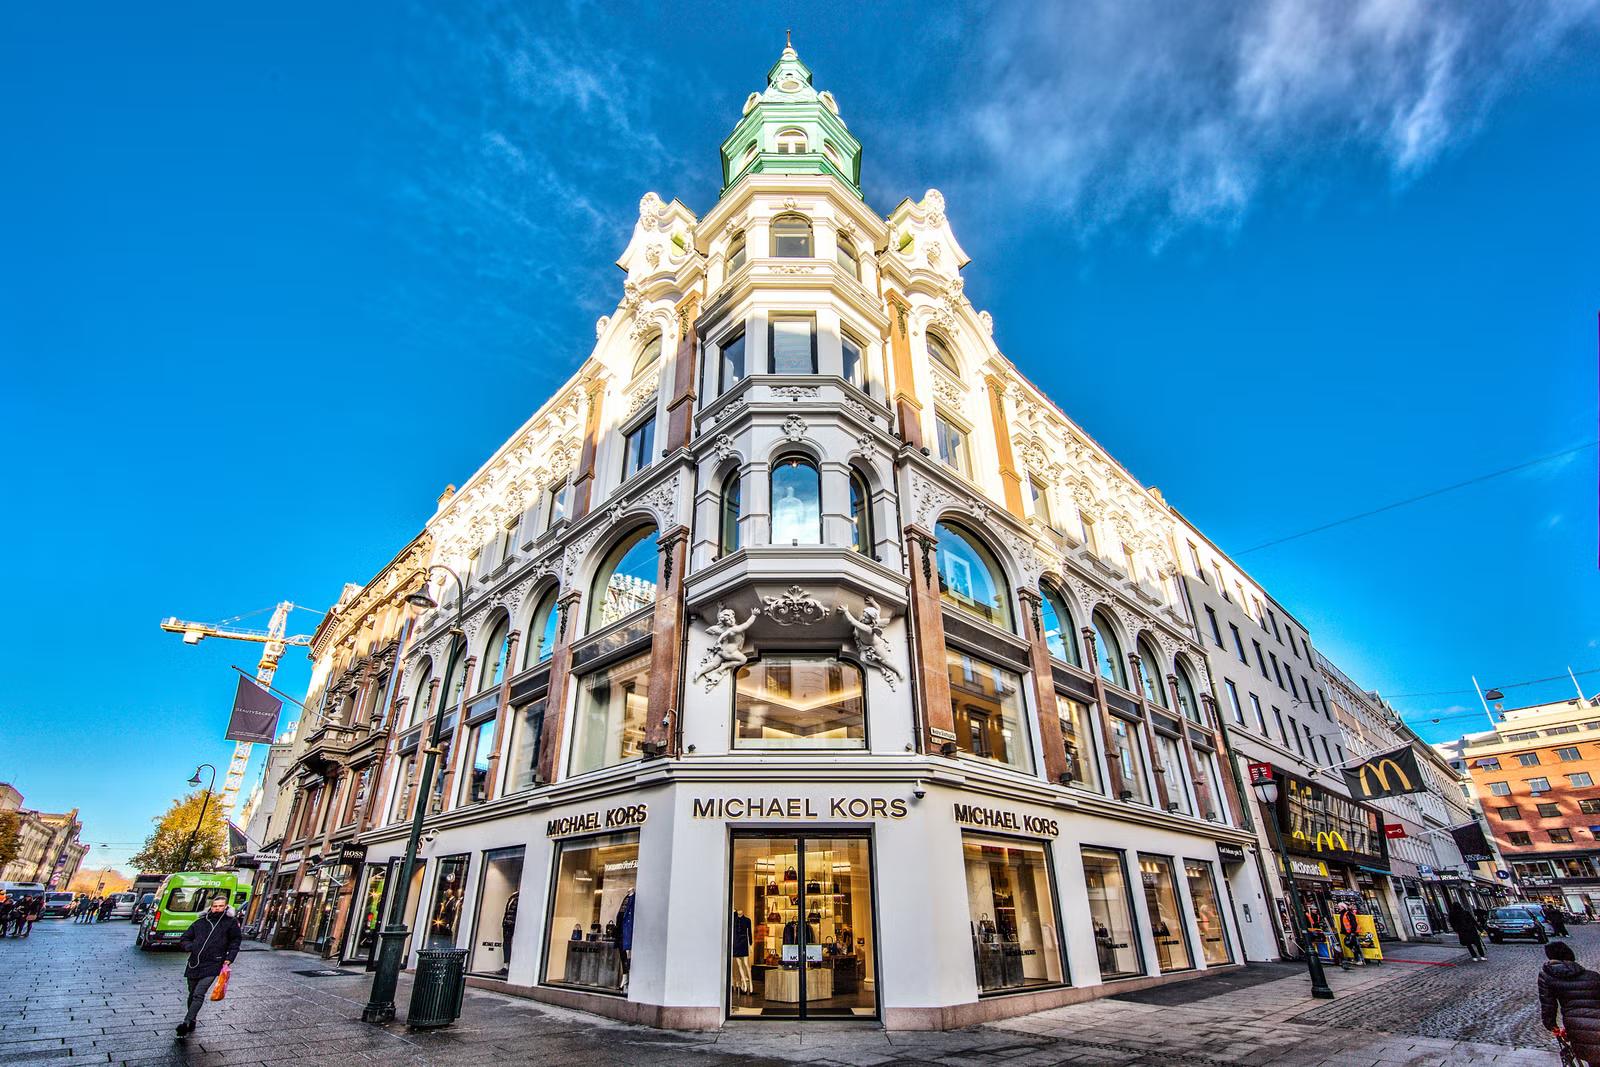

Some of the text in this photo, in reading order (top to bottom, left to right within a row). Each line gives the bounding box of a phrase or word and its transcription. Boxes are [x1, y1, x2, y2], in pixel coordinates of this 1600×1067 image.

[546, 804, 647, 837] MICHAEL KORS
[693, 798, 908, 819] MICHAEL KORS
[953, 803, 1060, 837] MICHAEL KORS
[199, 878, 221, 887] bring
